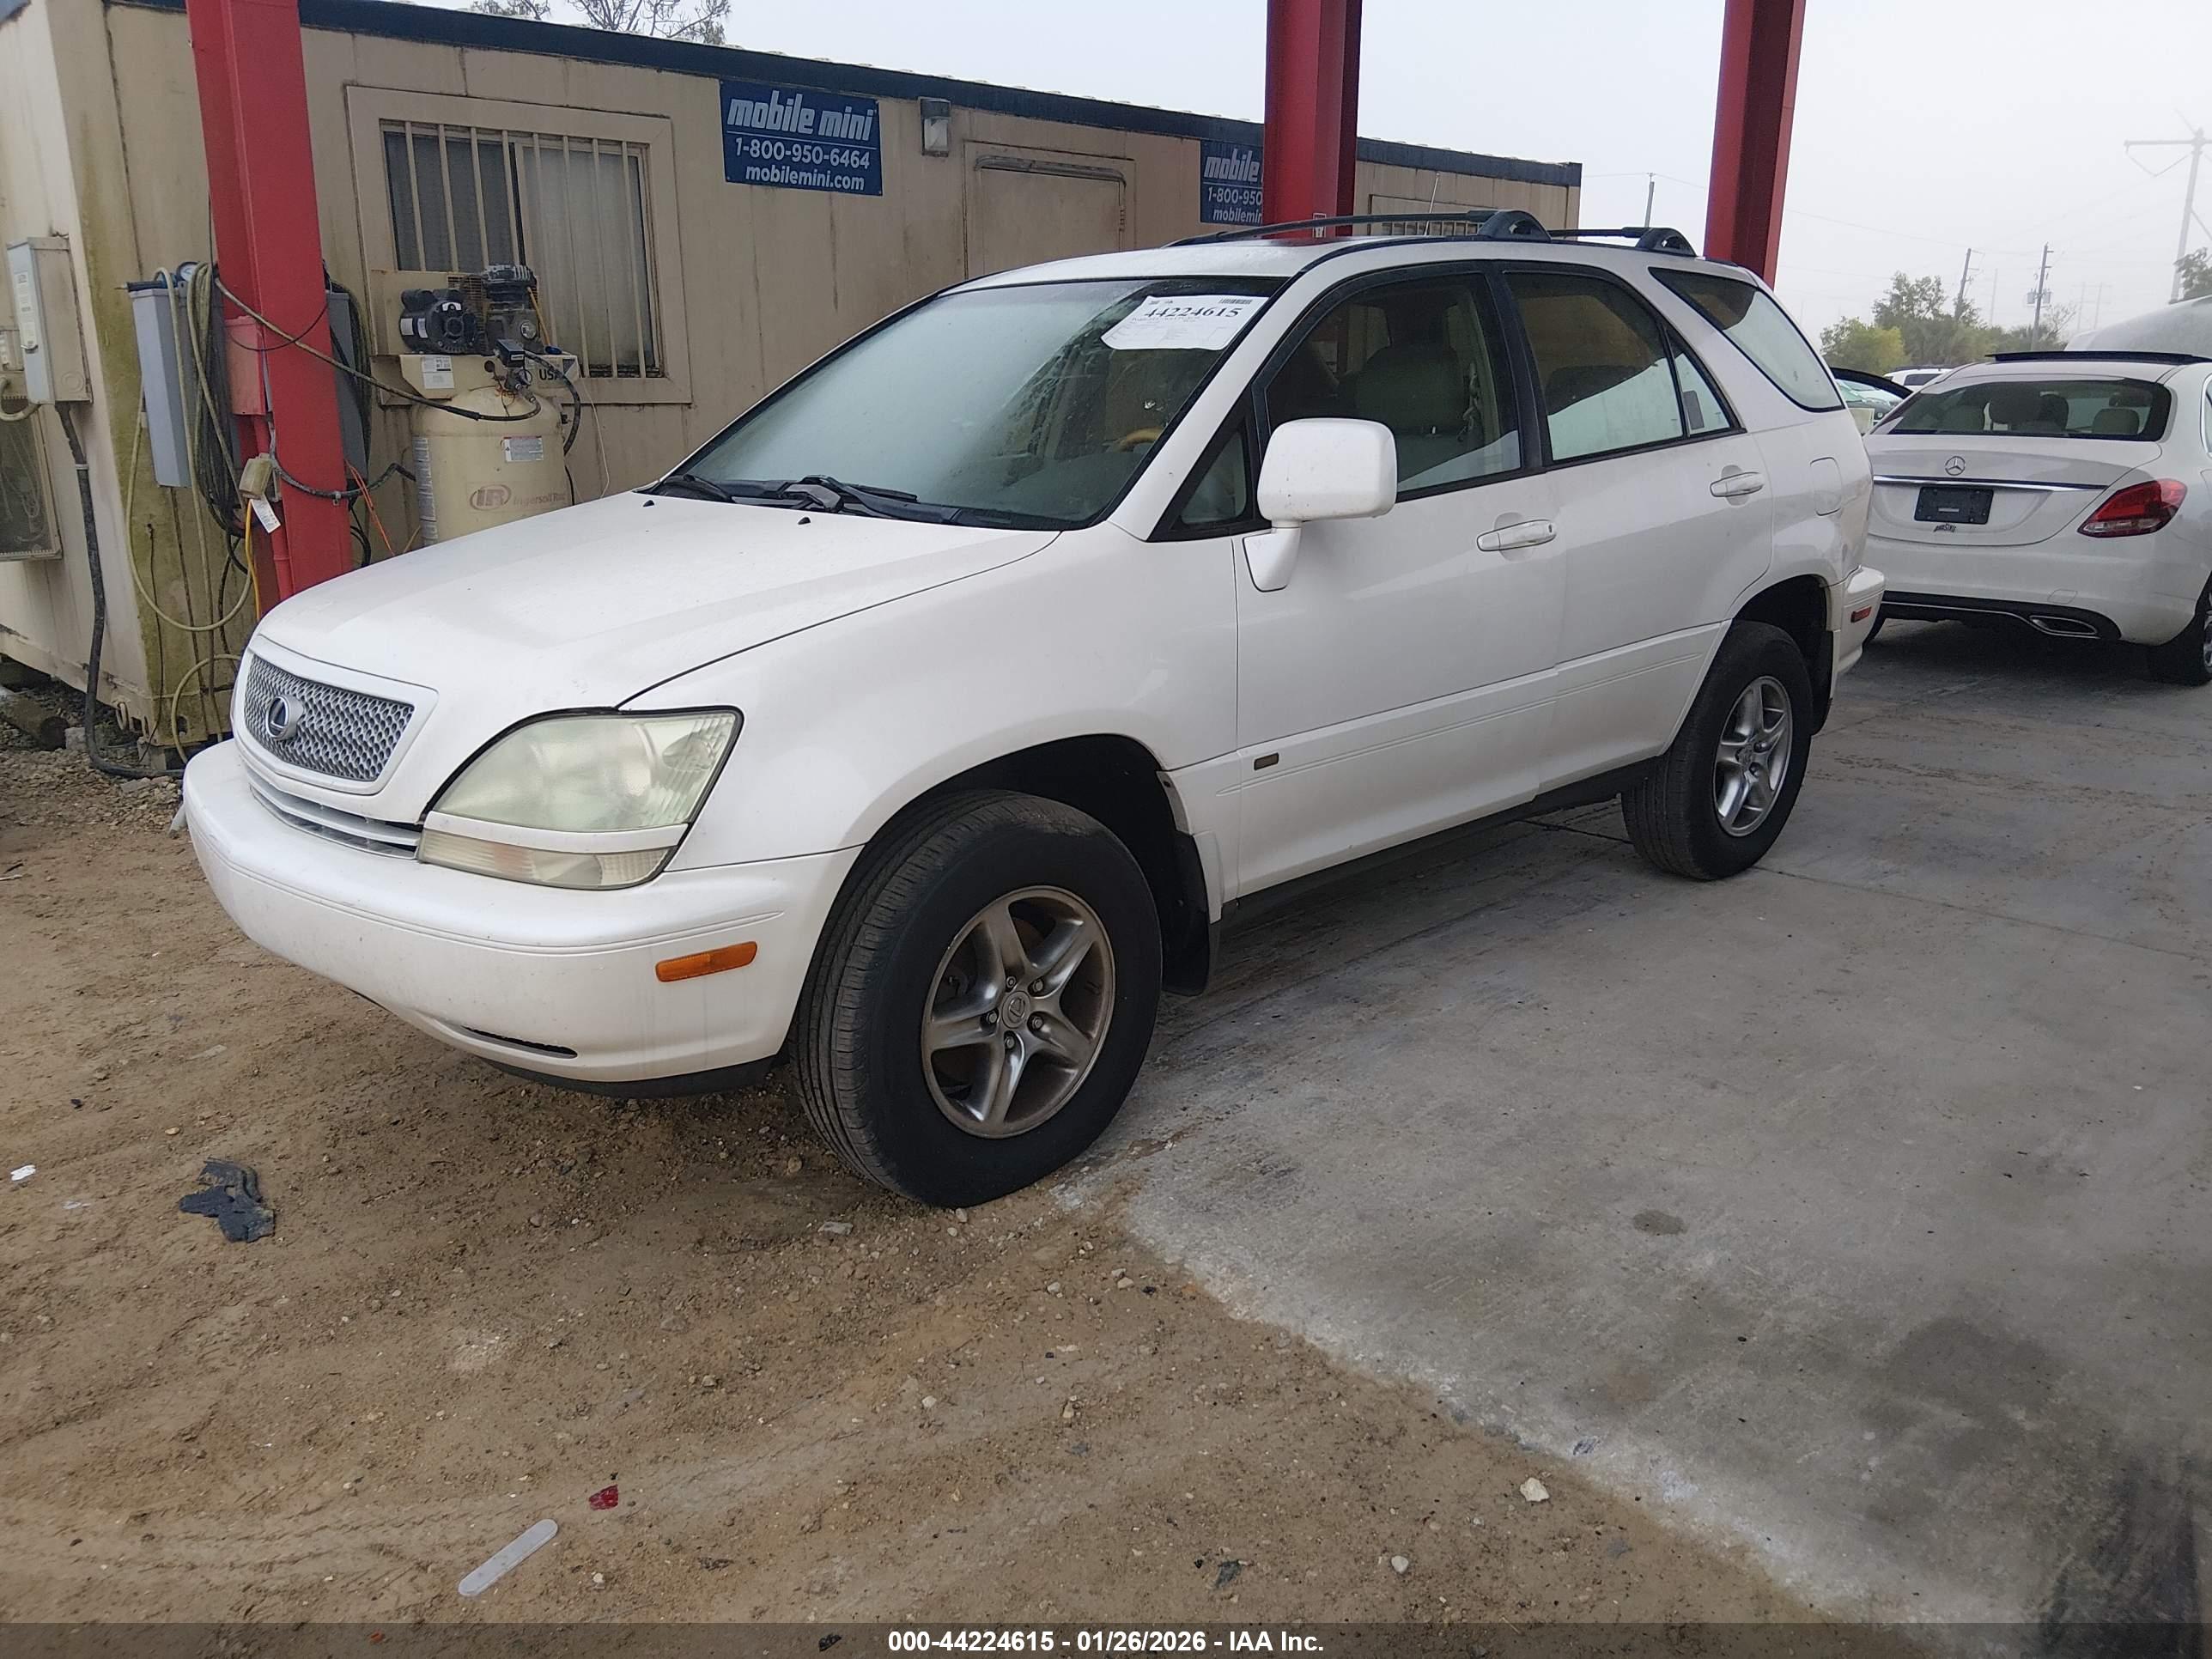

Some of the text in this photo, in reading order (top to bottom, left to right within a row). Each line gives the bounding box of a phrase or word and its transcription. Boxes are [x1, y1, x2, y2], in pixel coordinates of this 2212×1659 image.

[727, 90, 874, 141] mobile mini
[735, 137, 870, 169] 1-800-950-6464
[1204, 148, 1260, 182] mobile
[745, 164, 865, 191] mobilemini.com
[1144, 307, 1243, 318] 44224615
